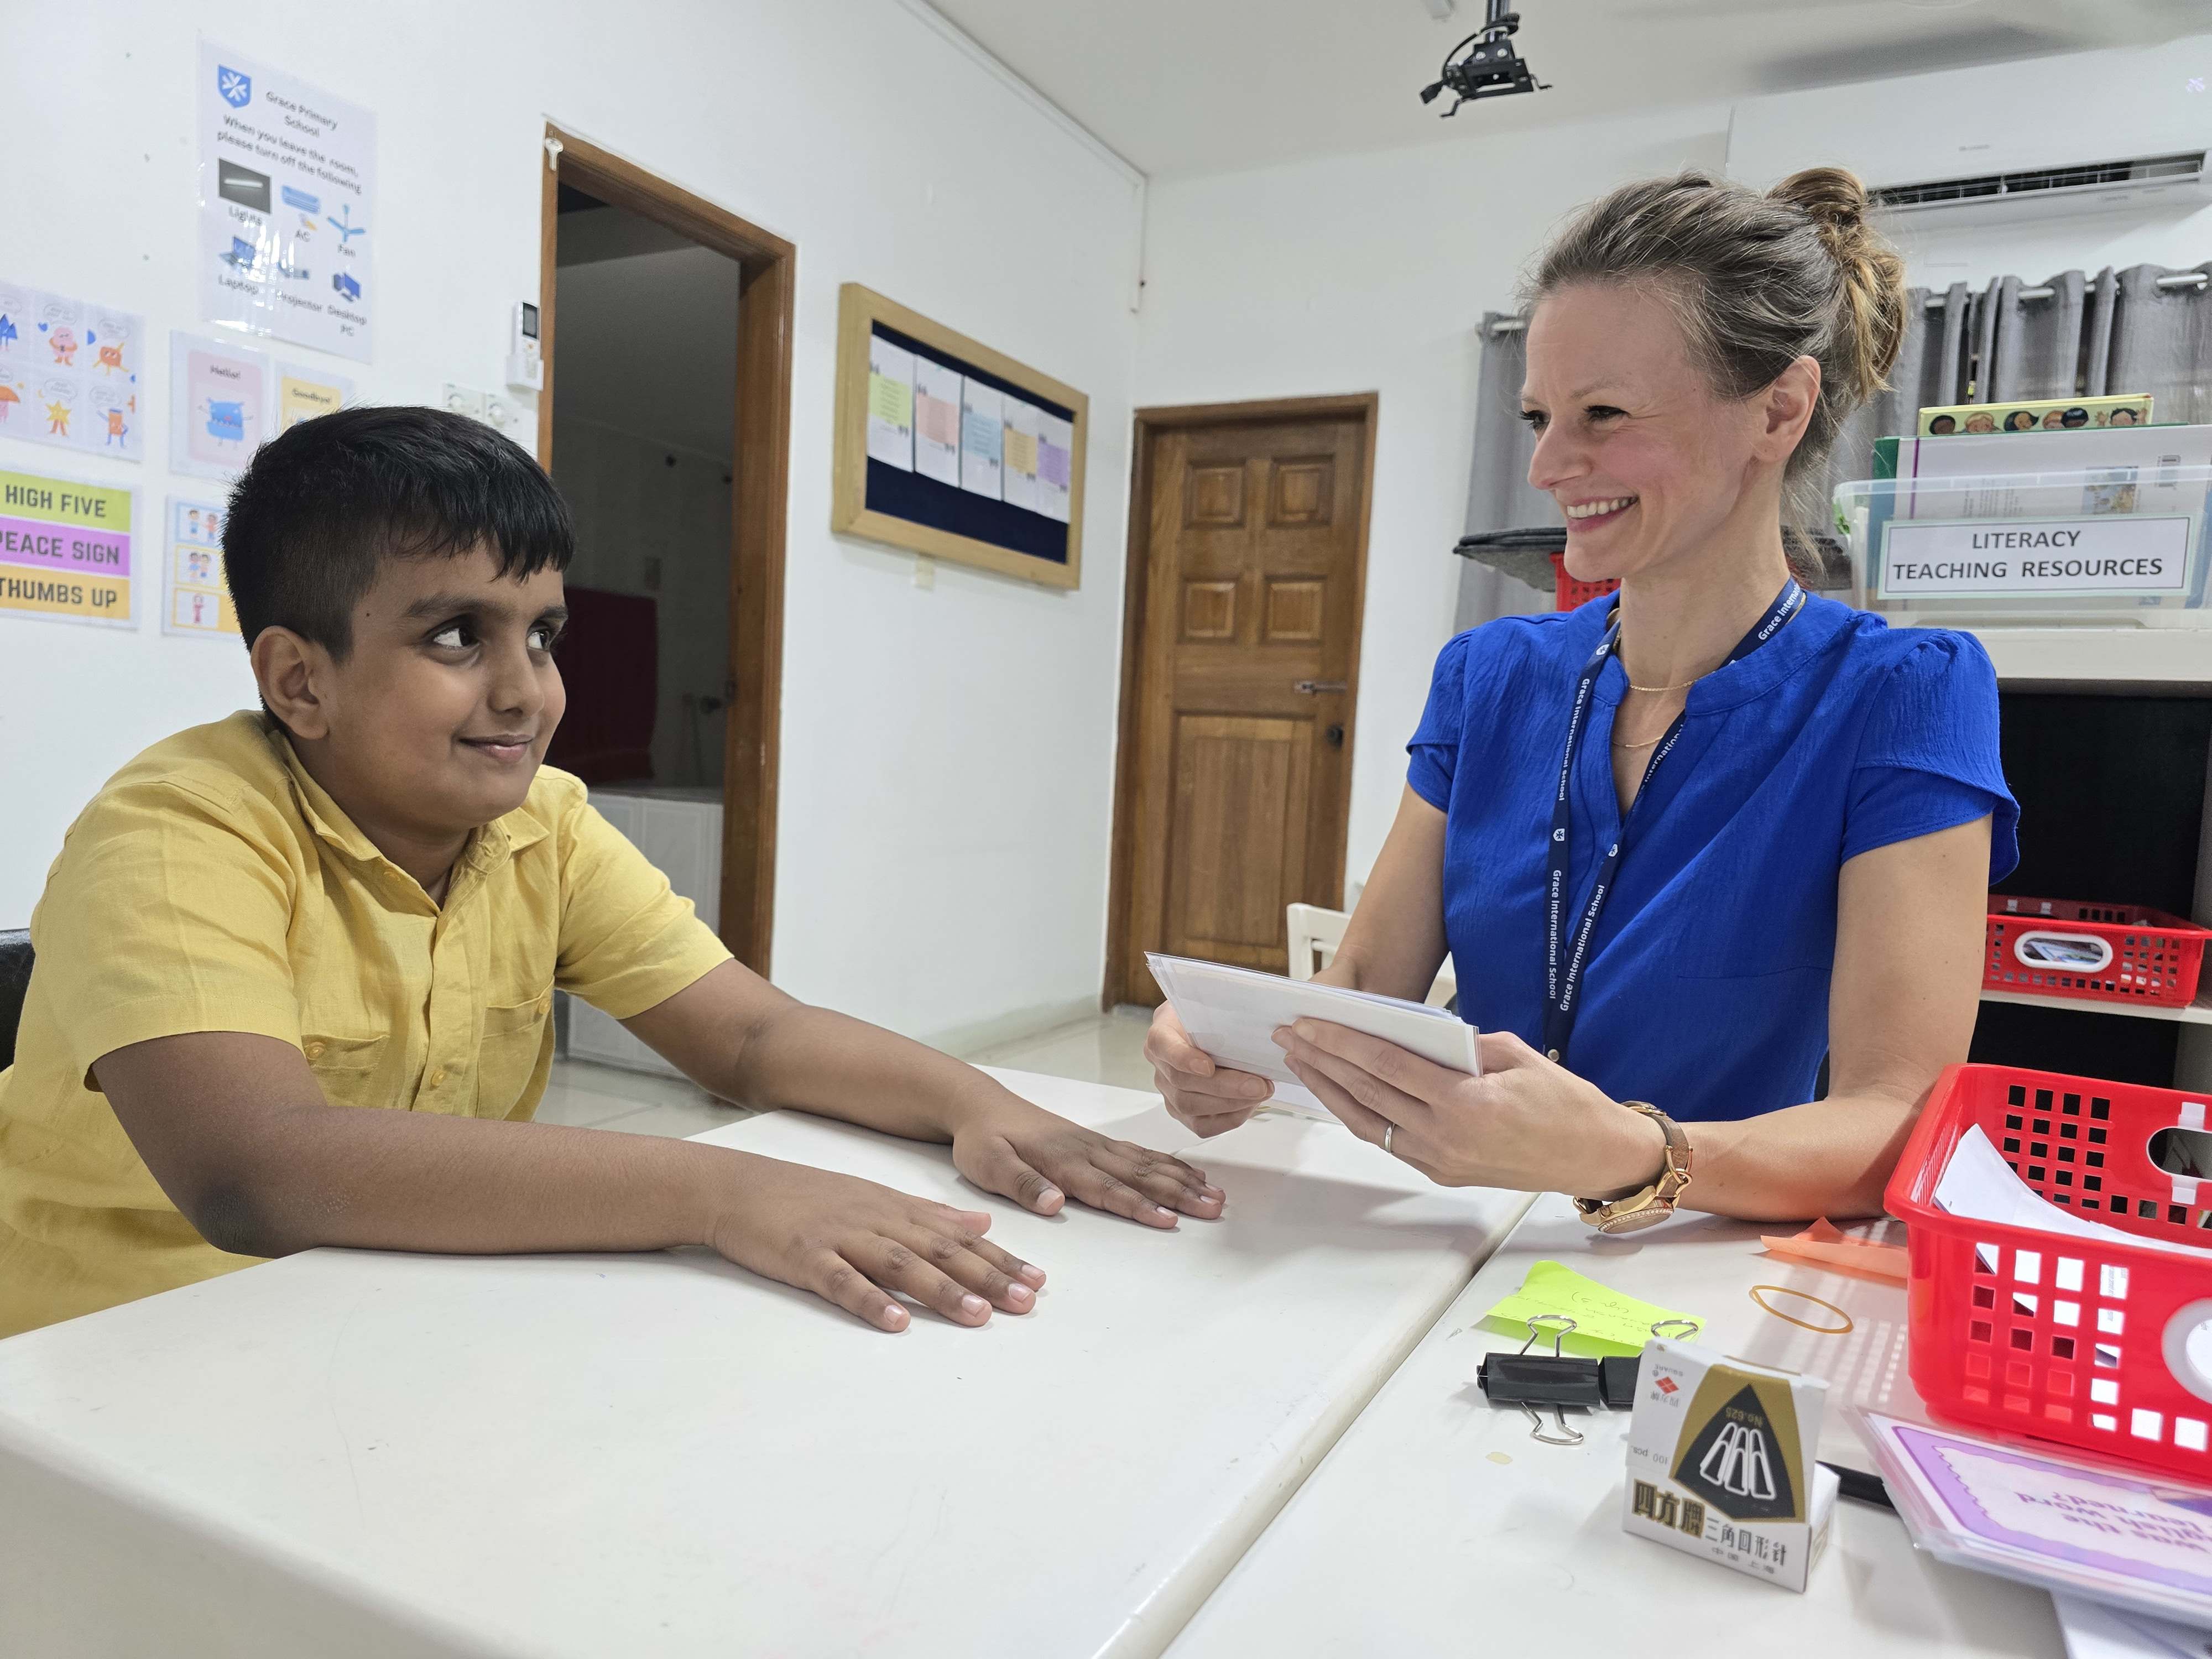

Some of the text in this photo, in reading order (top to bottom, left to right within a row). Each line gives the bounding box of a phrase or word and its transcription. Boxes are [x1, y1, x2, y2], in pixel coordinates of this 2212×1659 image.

[265, 91, 338, 131] Grace Primary
[223, 114, 255, 135] When
[257, 129, 277, 144] you
[279, 137, 307, 156] leave
[309, 149, 326, 163] the
[284, 115, 320, 137] School
[217, 131, 362, 195] please turn off the following
[295, 229, 311, 242] AC
[337, 243, 356, 258] Fan
[218, 274, 367, 326] Laptop rojector Desktop
[340, 324, 355, 337] PC
[210, 364, 241, 380] Hello!
[5, 484, 107, 518] HIGH FIVE
[0, 530, 119, 565] EACE SIGN
[1972, 530, 2081, 550] LITERACY
[1893, 558, 2164, 580] TEACHING RESOURCES
[91, 587, 117, 608] UP
[1757, 615, 1782, 640] Grace
[1559, 678, 1590, 801] Grace International School
[1549, 869, 1562, 999] Grace International School
[1560, 884, 1605, 1011] Grace International School
[1654, 1364, 1683, 1377] SQUARE
[1631, 1445, 1668, 1465] 100 pcs.
[1632, 1478, 1705, 1538] 四方牌
[2013, 1491, 2106, 1519] word
[2052, 1491, 2204, 1534] learned?
